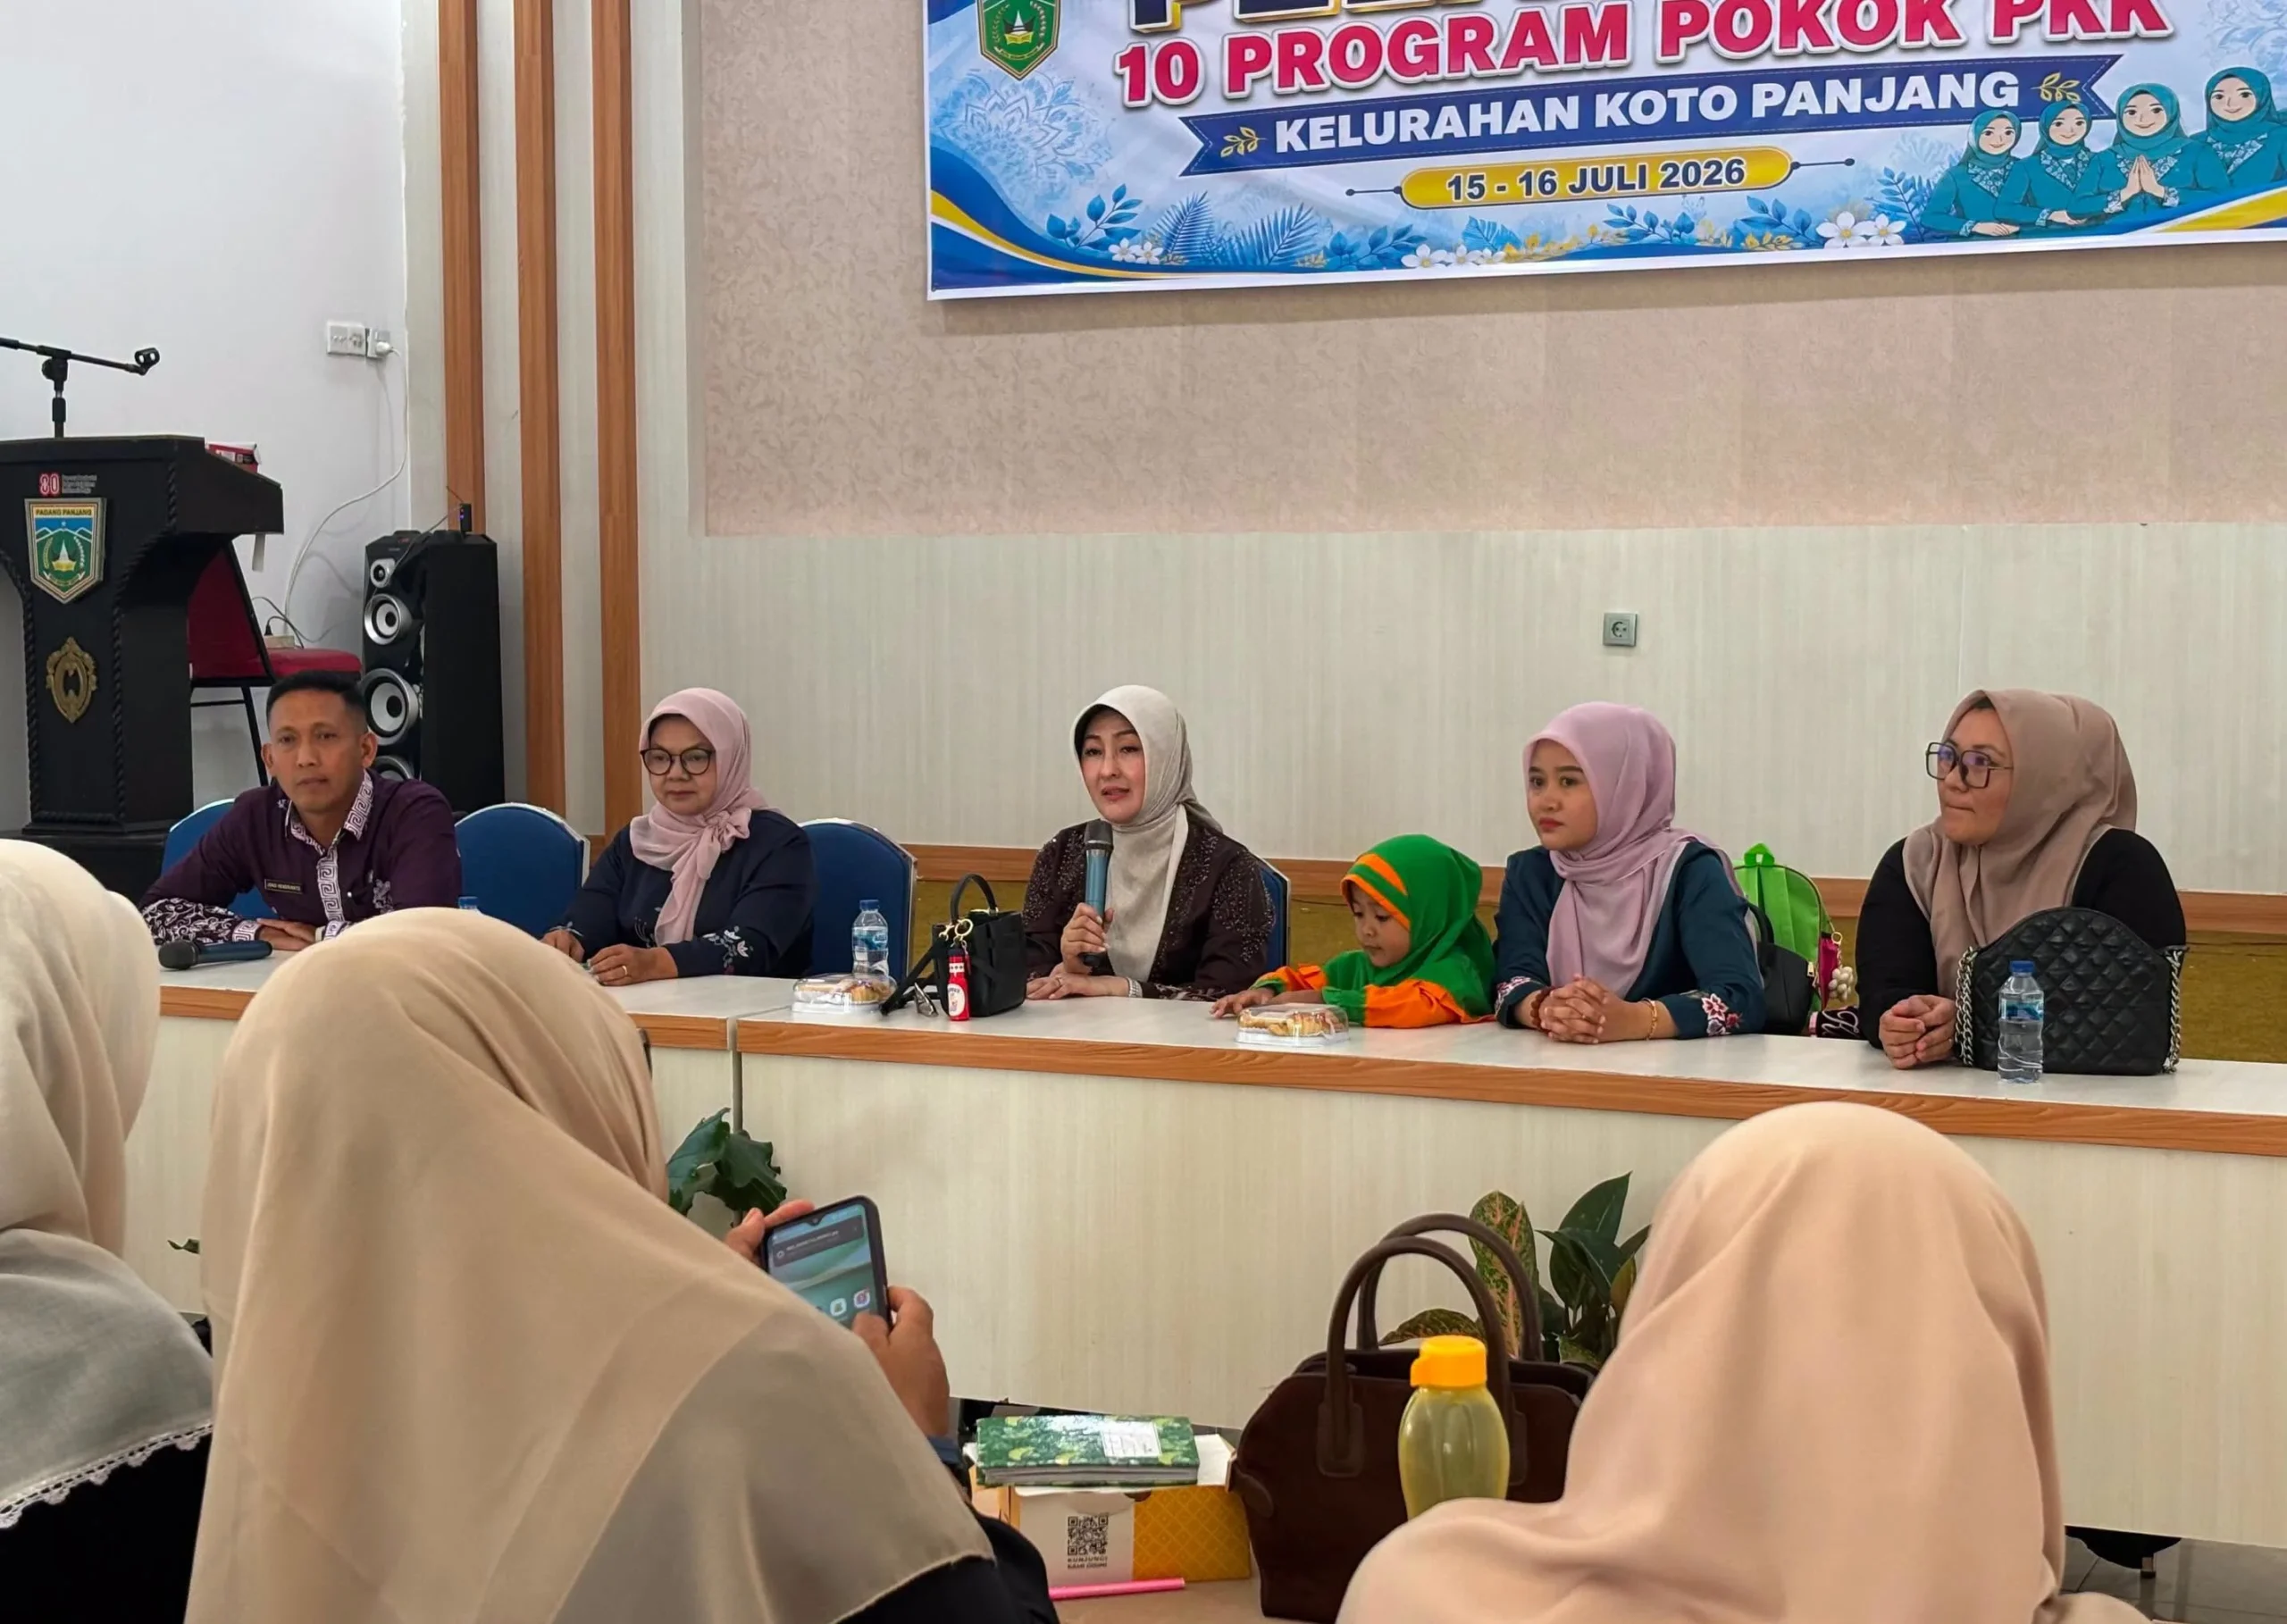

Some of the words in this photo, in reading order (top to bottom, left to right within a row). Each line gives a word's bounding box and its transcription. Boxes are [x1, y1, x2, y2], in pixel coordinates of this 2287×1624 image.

[1118, 39, 1201, 104] 10
[1226, 4, 1629, 95] PROGRAM
[1659, 0, 1964, 58] POKOK
[1991, 0, 2170, 38] PKK
[1275, 95, 1579, 154] KELURAHAN
[1595, 85, 1738, 128] KOTO
[1751, 71, 2019, 118] PANJANG
[1447, 173, 1487, 202] 15
[1518, 169, 1558, 197] 16
[1568, 163, 1647, 195] JULI
[1659, 157, 1747, 189] 2026
